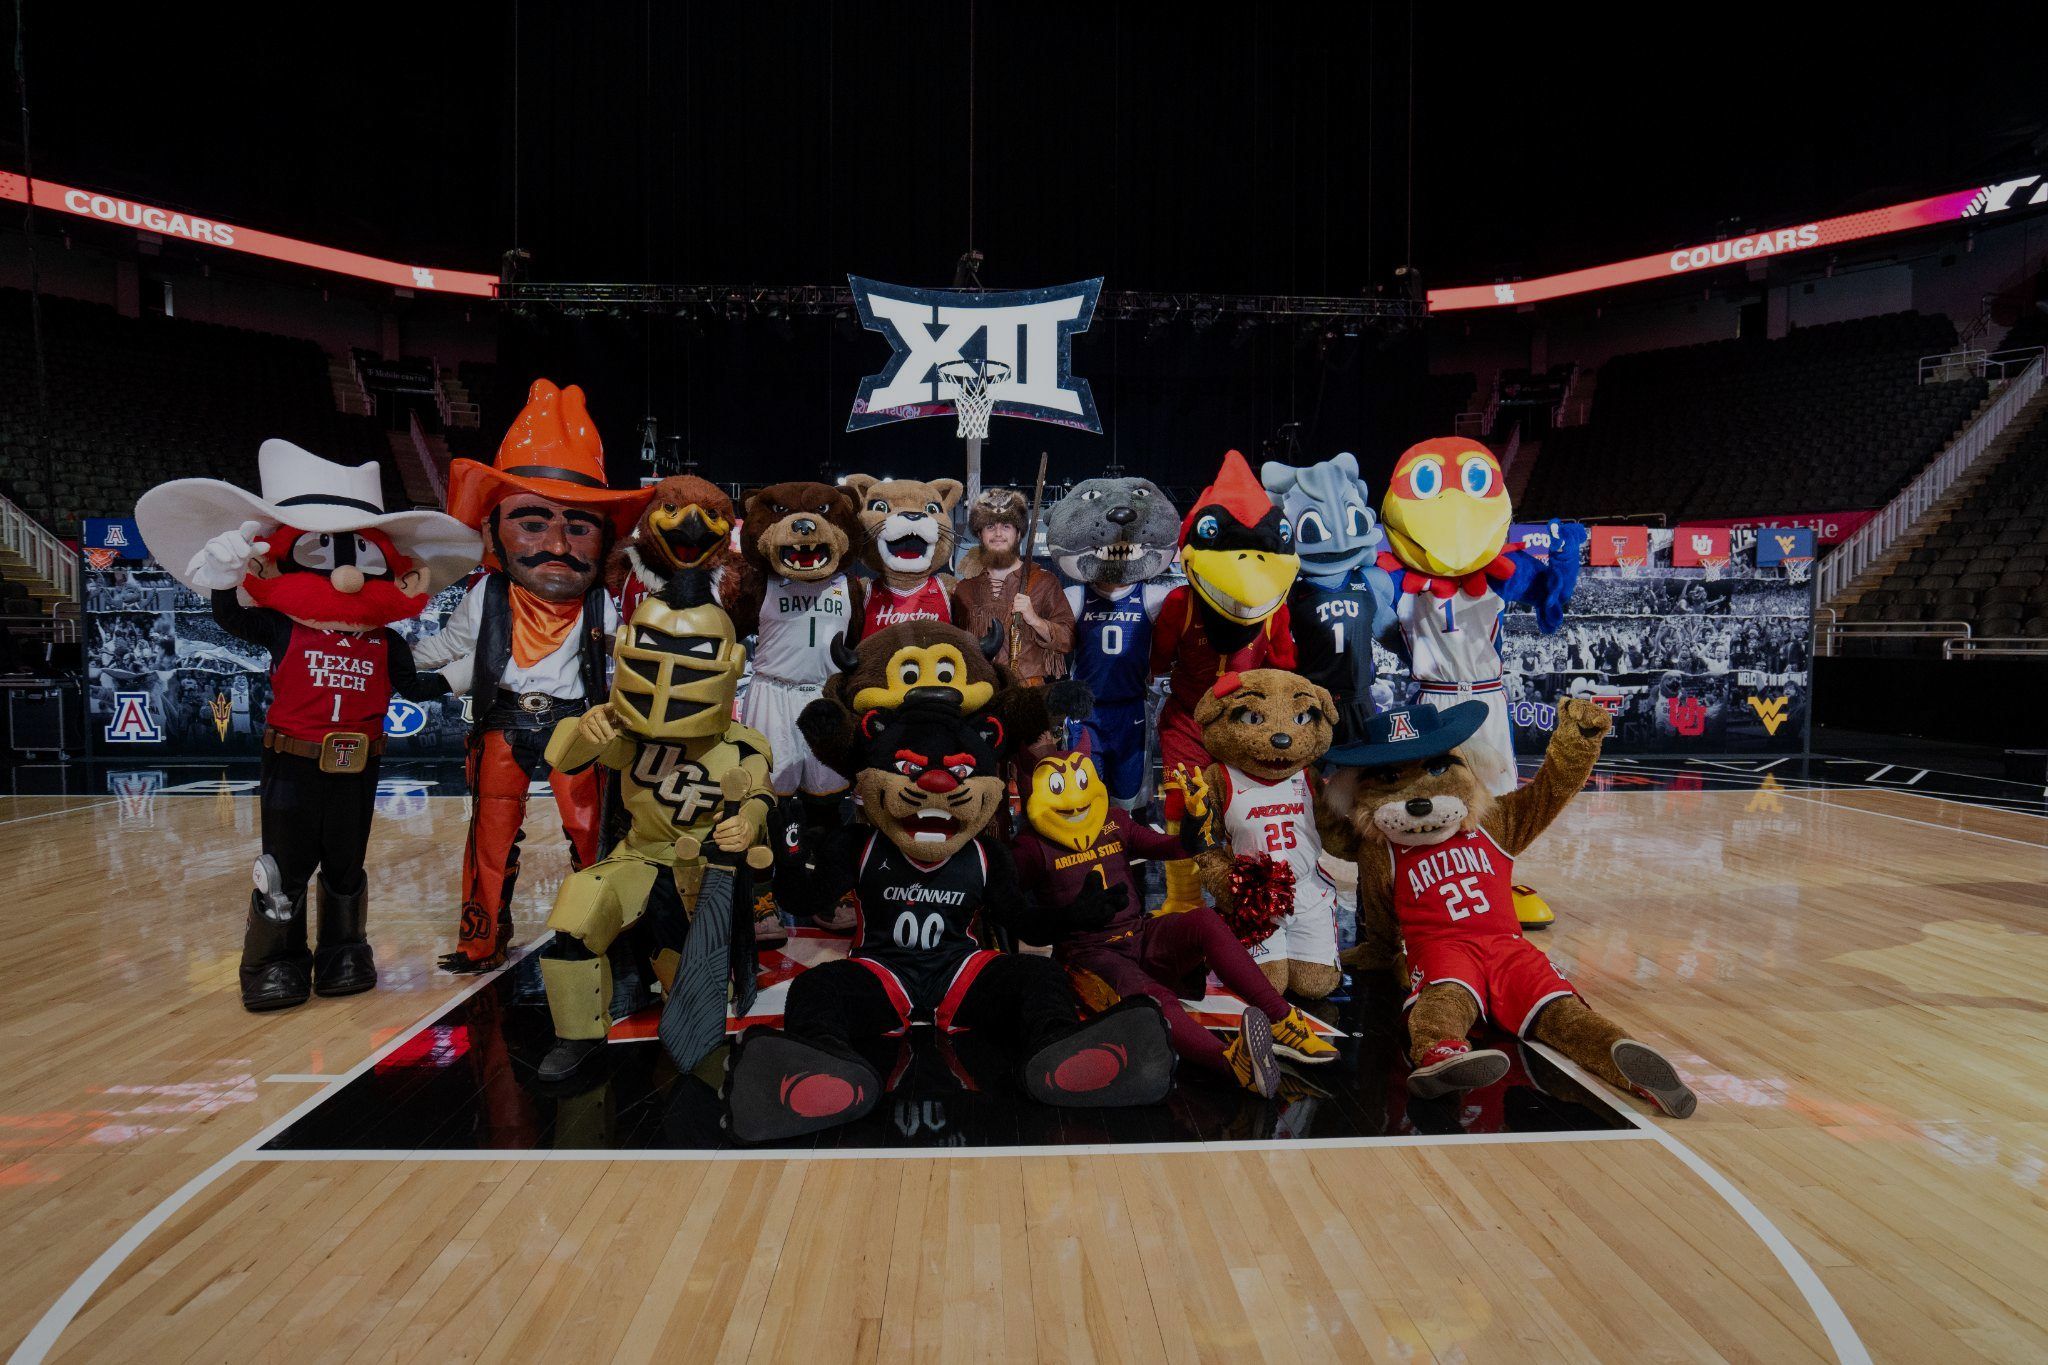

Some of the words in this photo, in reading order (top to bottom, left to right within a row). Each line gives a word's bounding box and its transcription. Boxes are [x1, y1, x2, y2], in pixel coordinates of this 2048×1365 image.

[64, 190, 235, 245] COUGARS
[1670, 224, 1819, 271] COUGARS
[779, 595, 843, 617] BAYLOR
[1083, 611, 1142, 622] K-STATE
[1316, 599, 1359, 623] TCU
[1438, 599, 1460, 633] 1
[809, 616, 816, 648] 1
[1101, 625, 1123, 655] 0
[1331, 622, 1345, 654] 1
[304, 650, 374, 676] TEXAS
[309, 668, 366, 692] TECH
[104, 691, 162, 743] A
[331, 694, 342, 722] 1
[1388, 711, 1420, 743] A
[634, 744, 723, 822] UCF
[1246, 802, 1305, 820] ARIZONA
[1264, 821, 1297, 852] 25
[1054, 848, 1098, 871] ARIZONA
[1097, 841, 1124, 857] STATE
[1407, 846, 1496, 900] ARIZONA
[883, 885, 966, 906] CINCINNATI
[1438, 876, 1491, 922] 25
[893, 911, 945, 951] 00
